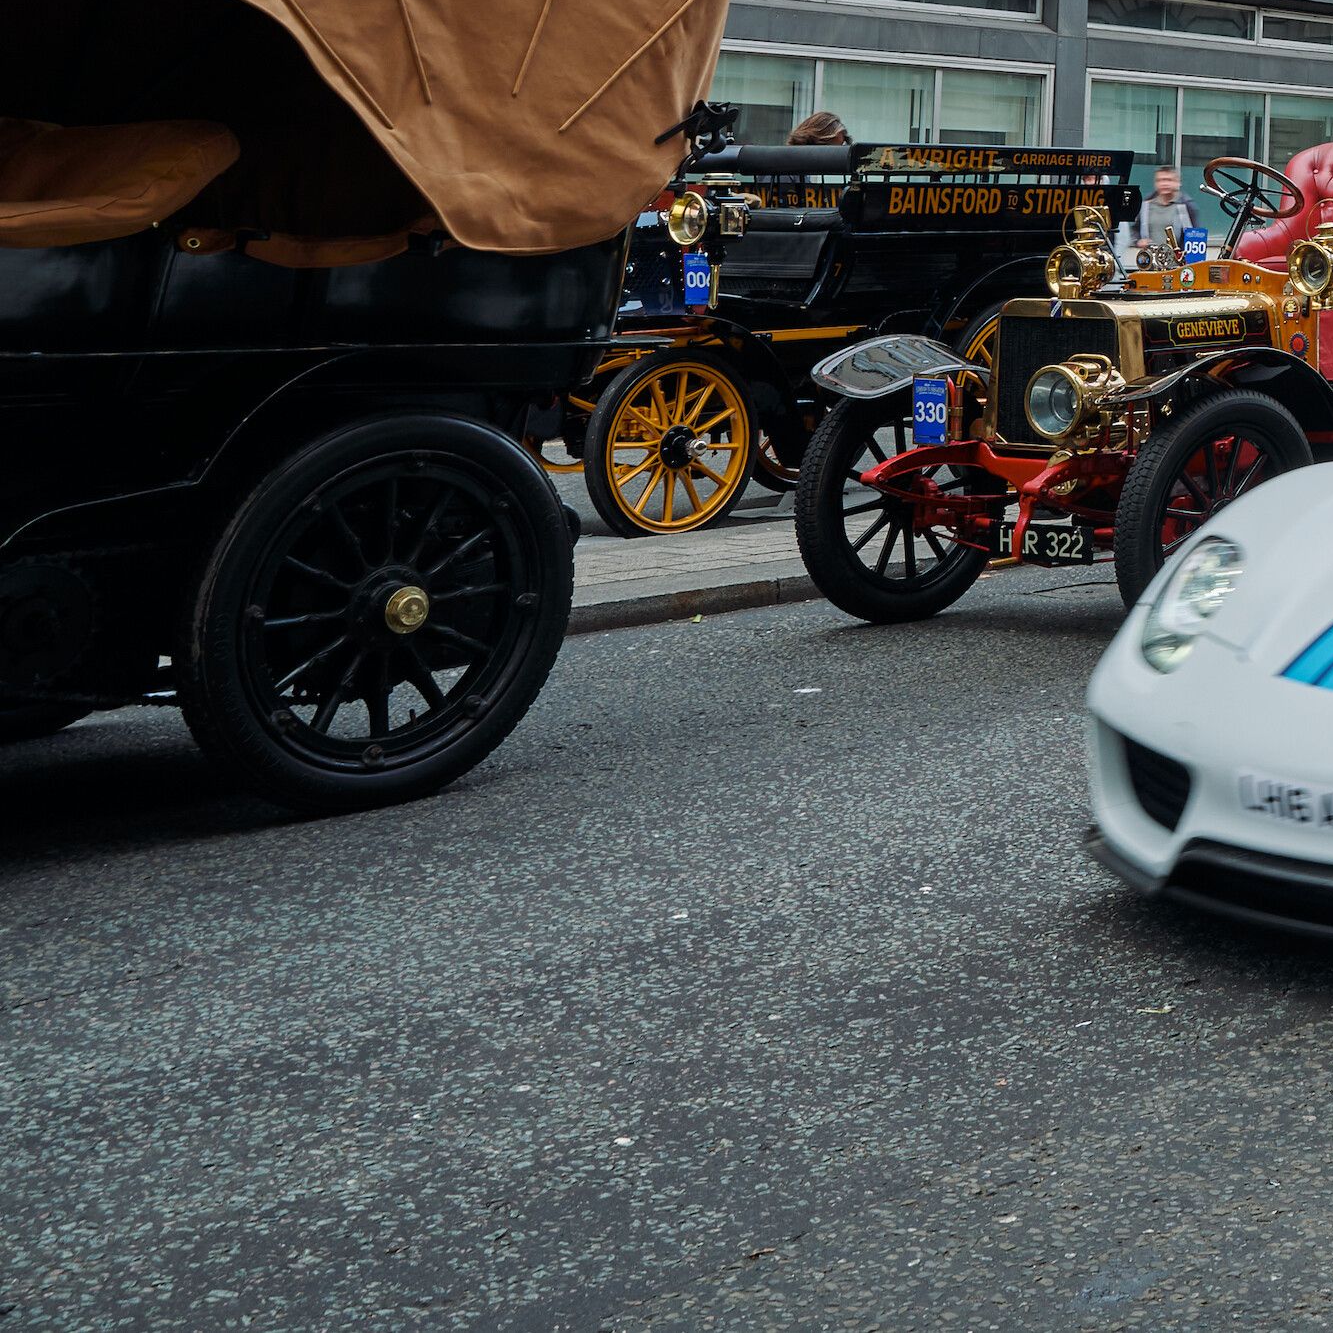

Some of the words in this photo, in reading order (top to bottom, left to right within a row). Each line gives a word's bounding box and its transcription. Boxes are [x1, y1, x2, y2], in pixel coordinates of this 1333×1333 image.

[907, 149, 1000, 169] WRIGHT
[1013, 153, 1073, 166] CARRIAGE
[1077, 154, 1112, 167] HIRER
[888, 187, 1002, 215] BAINSFORD
[1007, 194, 1018, 206] TO
[1022, 189, 1105, 214] STIRLING
[1184, 241, 1207, 254] 050
[1176, 319, 1240, 338] GENEVIEVE
[915, 401, 946, 424] 330
[1000, 528, 1038, 554] HR
[1046, 531, 1083, 558] 322
